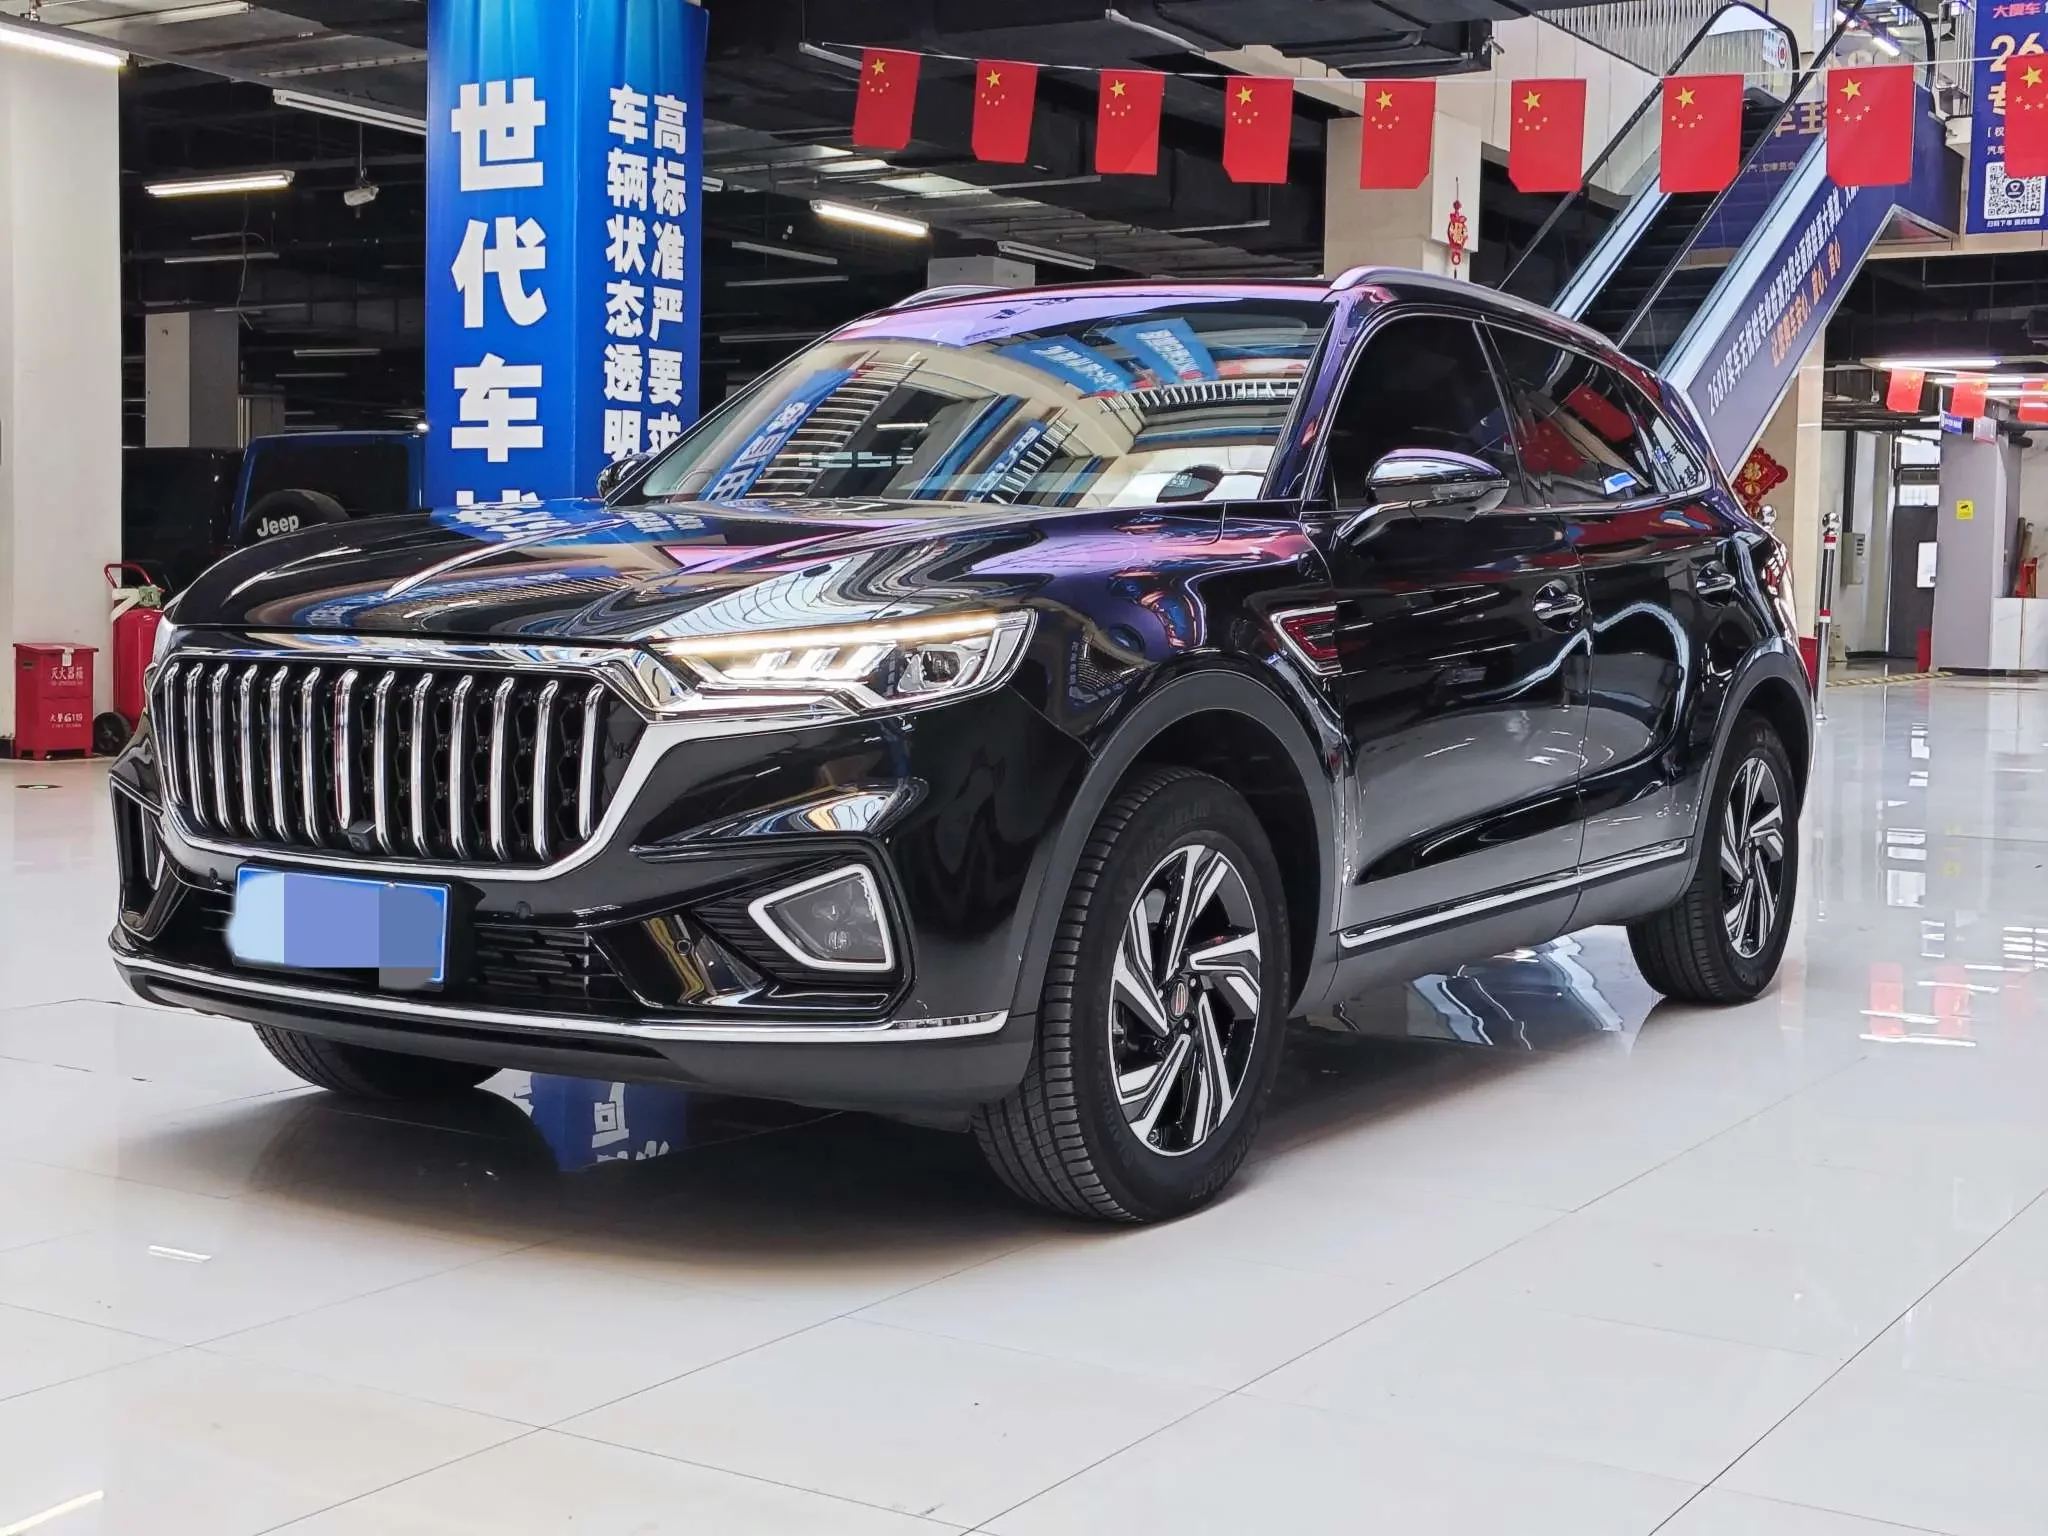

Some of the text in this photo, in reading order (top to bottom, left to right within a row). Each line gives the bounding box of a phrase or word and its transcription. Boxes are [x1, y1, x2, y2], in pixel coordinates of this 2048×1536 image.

[450, 77, 547, 507] 世代车
[604, 84, 648, 462] 车辆状态透明
[647, 94, 689, 459] 高标准严要求
[256, 515, 300, 537] Jeep
